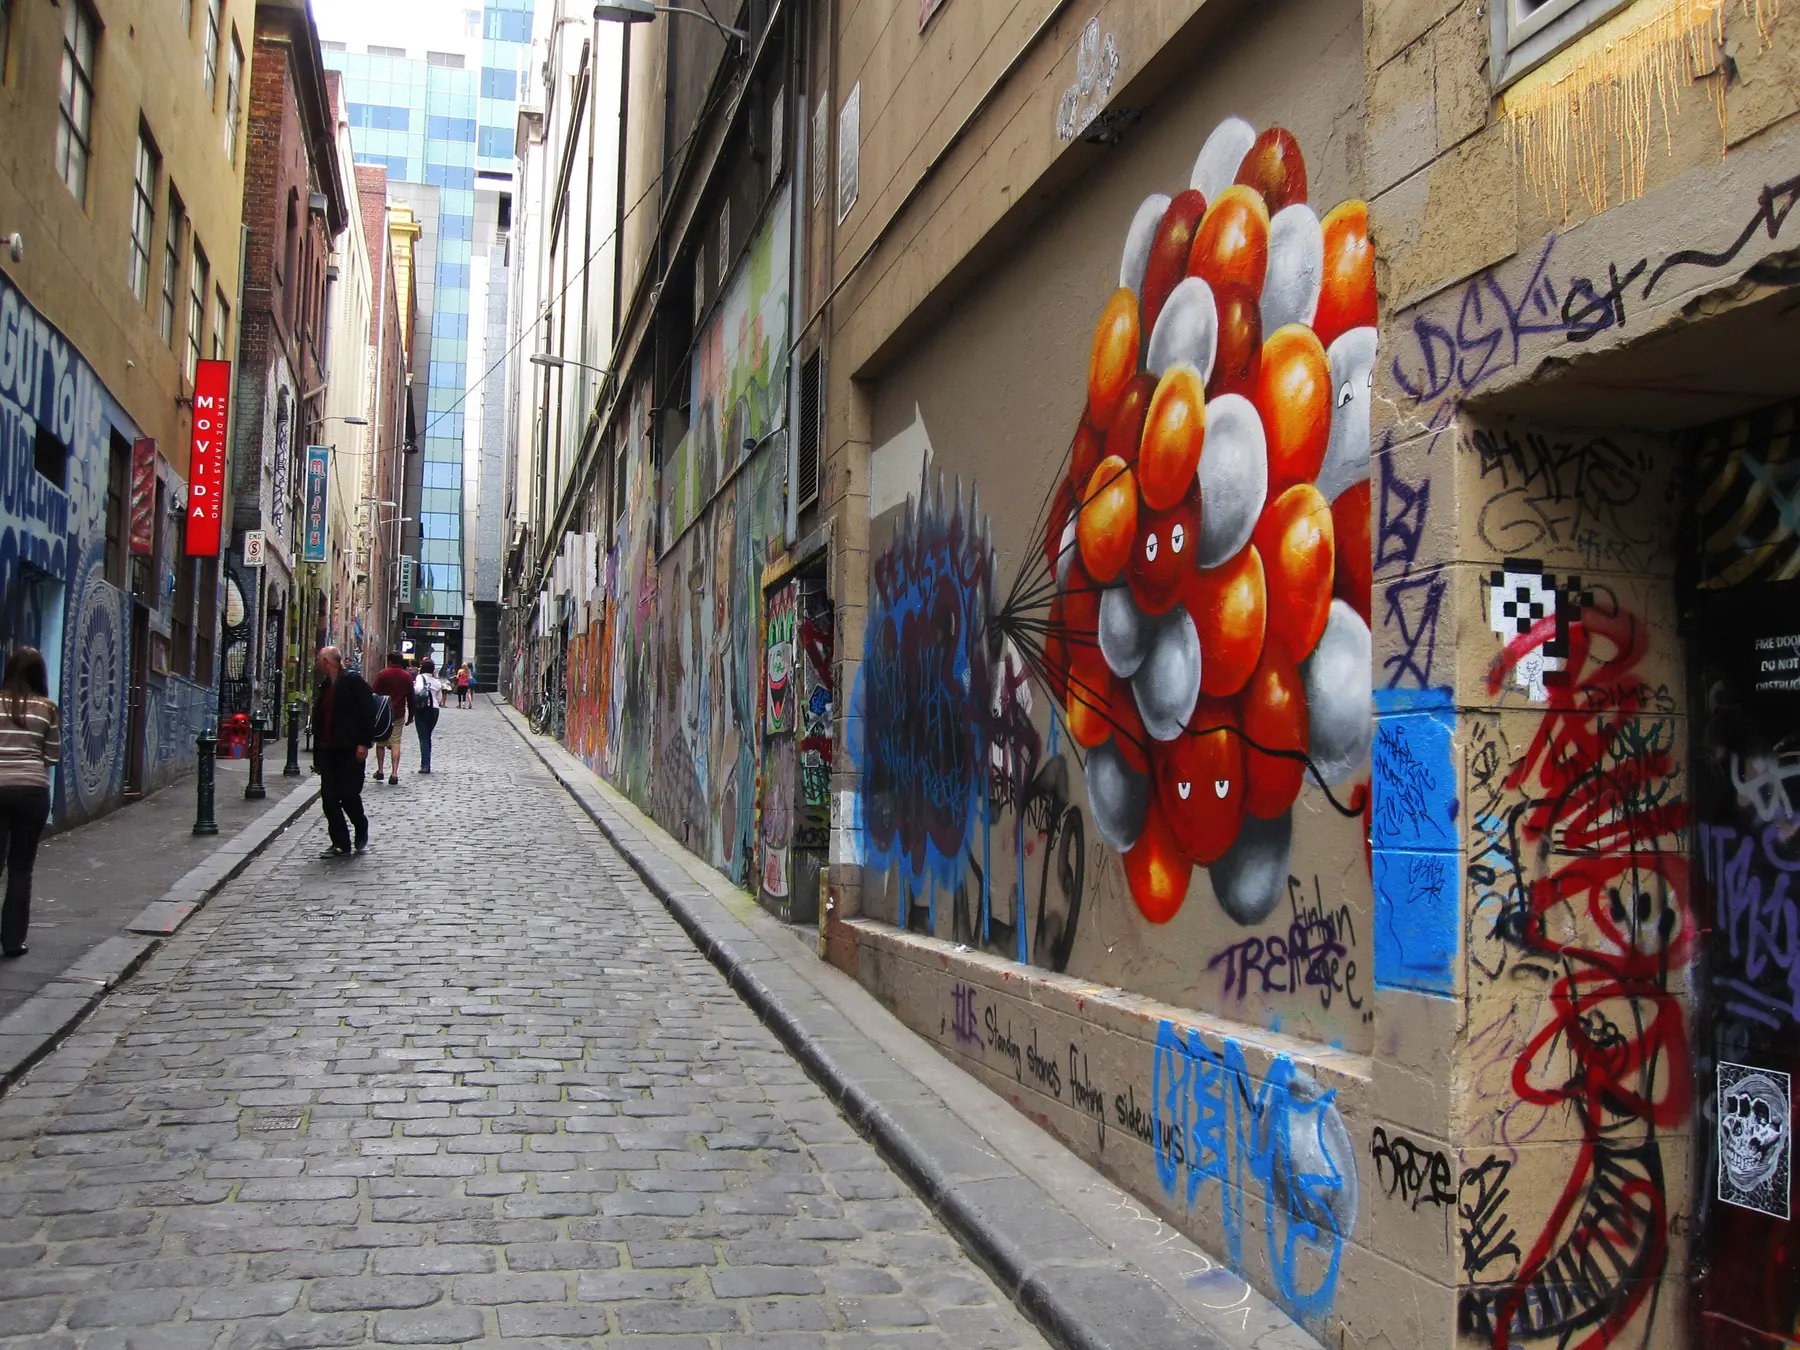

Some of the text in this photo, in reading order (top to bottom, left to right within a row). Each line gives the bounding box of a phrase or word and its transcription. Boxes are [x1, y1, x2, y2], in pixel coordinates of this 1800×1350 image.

[216, 397, 225, 417] BAR
[215, 422, 224, 435] DE
[192, 395, 213, 518] MOVIDA
[213, 441, 223, 474] TAPAS
[211, 492, 220, 519] VINO
[248, 533, 262, 541] END
[402, 640, 413, 653] P
[1755, 637, 1775, 650] FIRE
[1760, 657, 1799, 672] DO NOT
[984, 1003, 1022, 1084] Standing
[1115, 1084, 1185, 1164] sidewys
